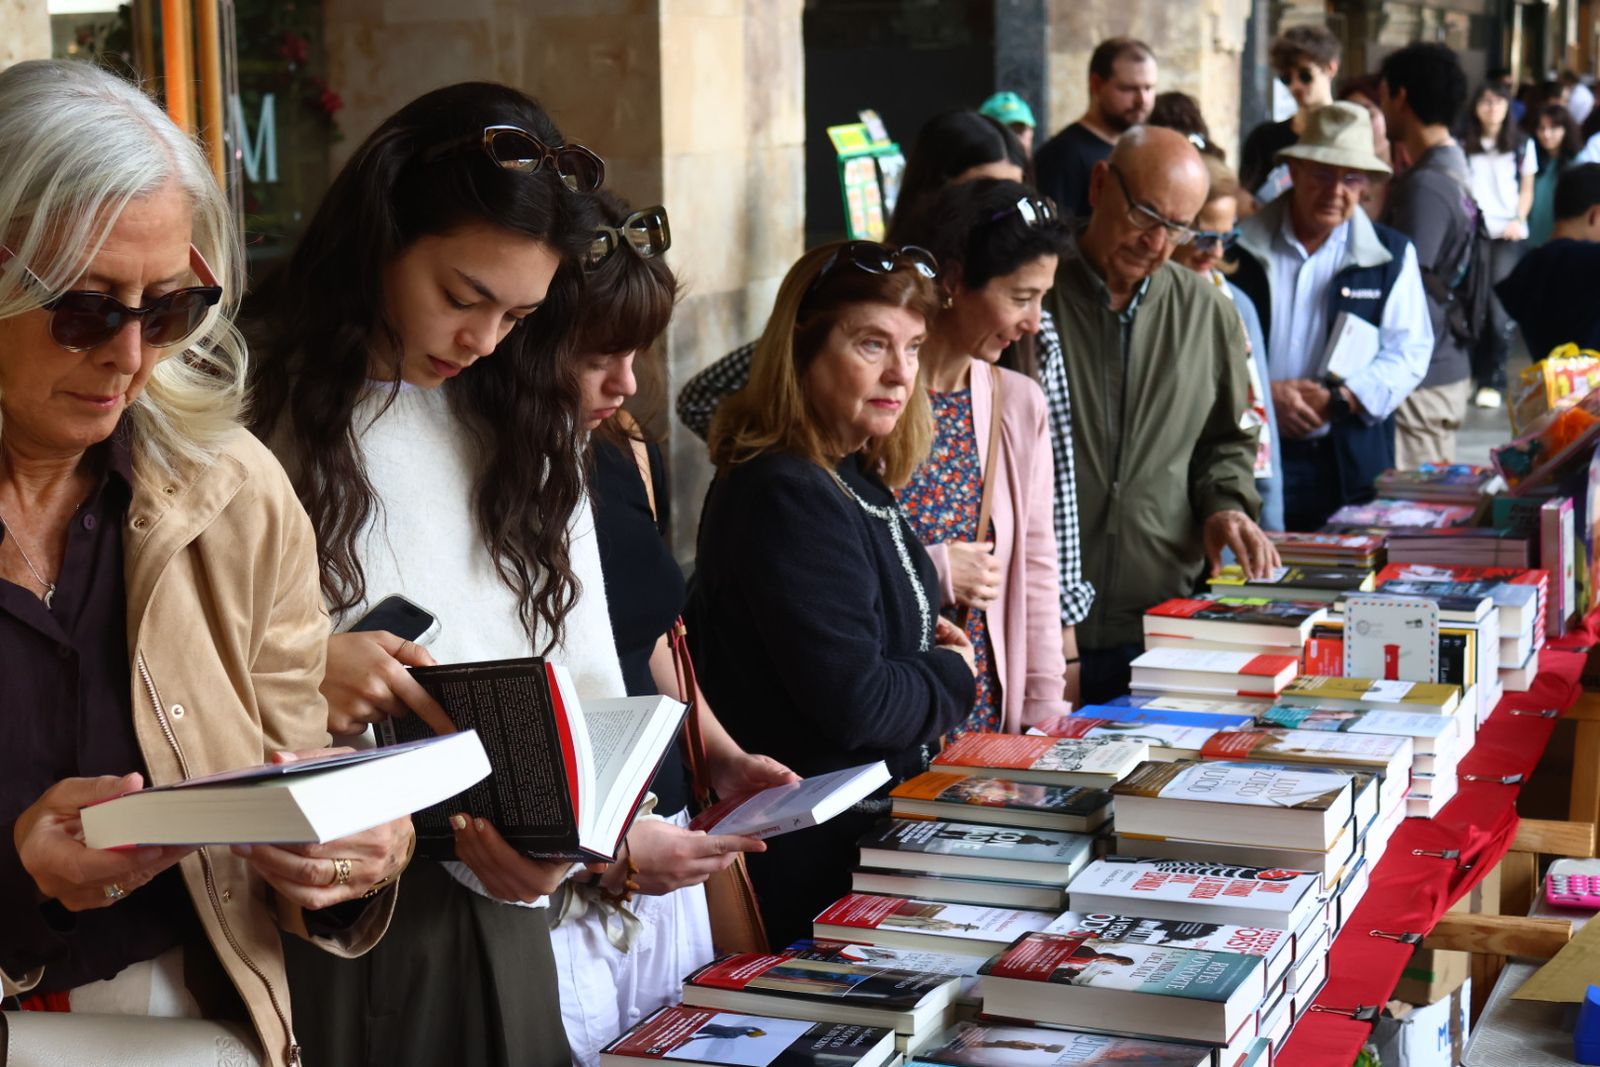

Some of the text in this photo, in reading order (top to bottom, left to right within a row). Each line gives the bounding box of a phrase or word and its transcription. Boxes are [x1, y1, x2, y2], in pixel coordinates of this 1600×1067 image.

[1187, 766, 1231, 793] JUICIO
[1235, 770, 1277, 797] ZUECO
[1165, 952, 1216, 991] MONFORTE
[1194, 961, 1230, 985] REYES
